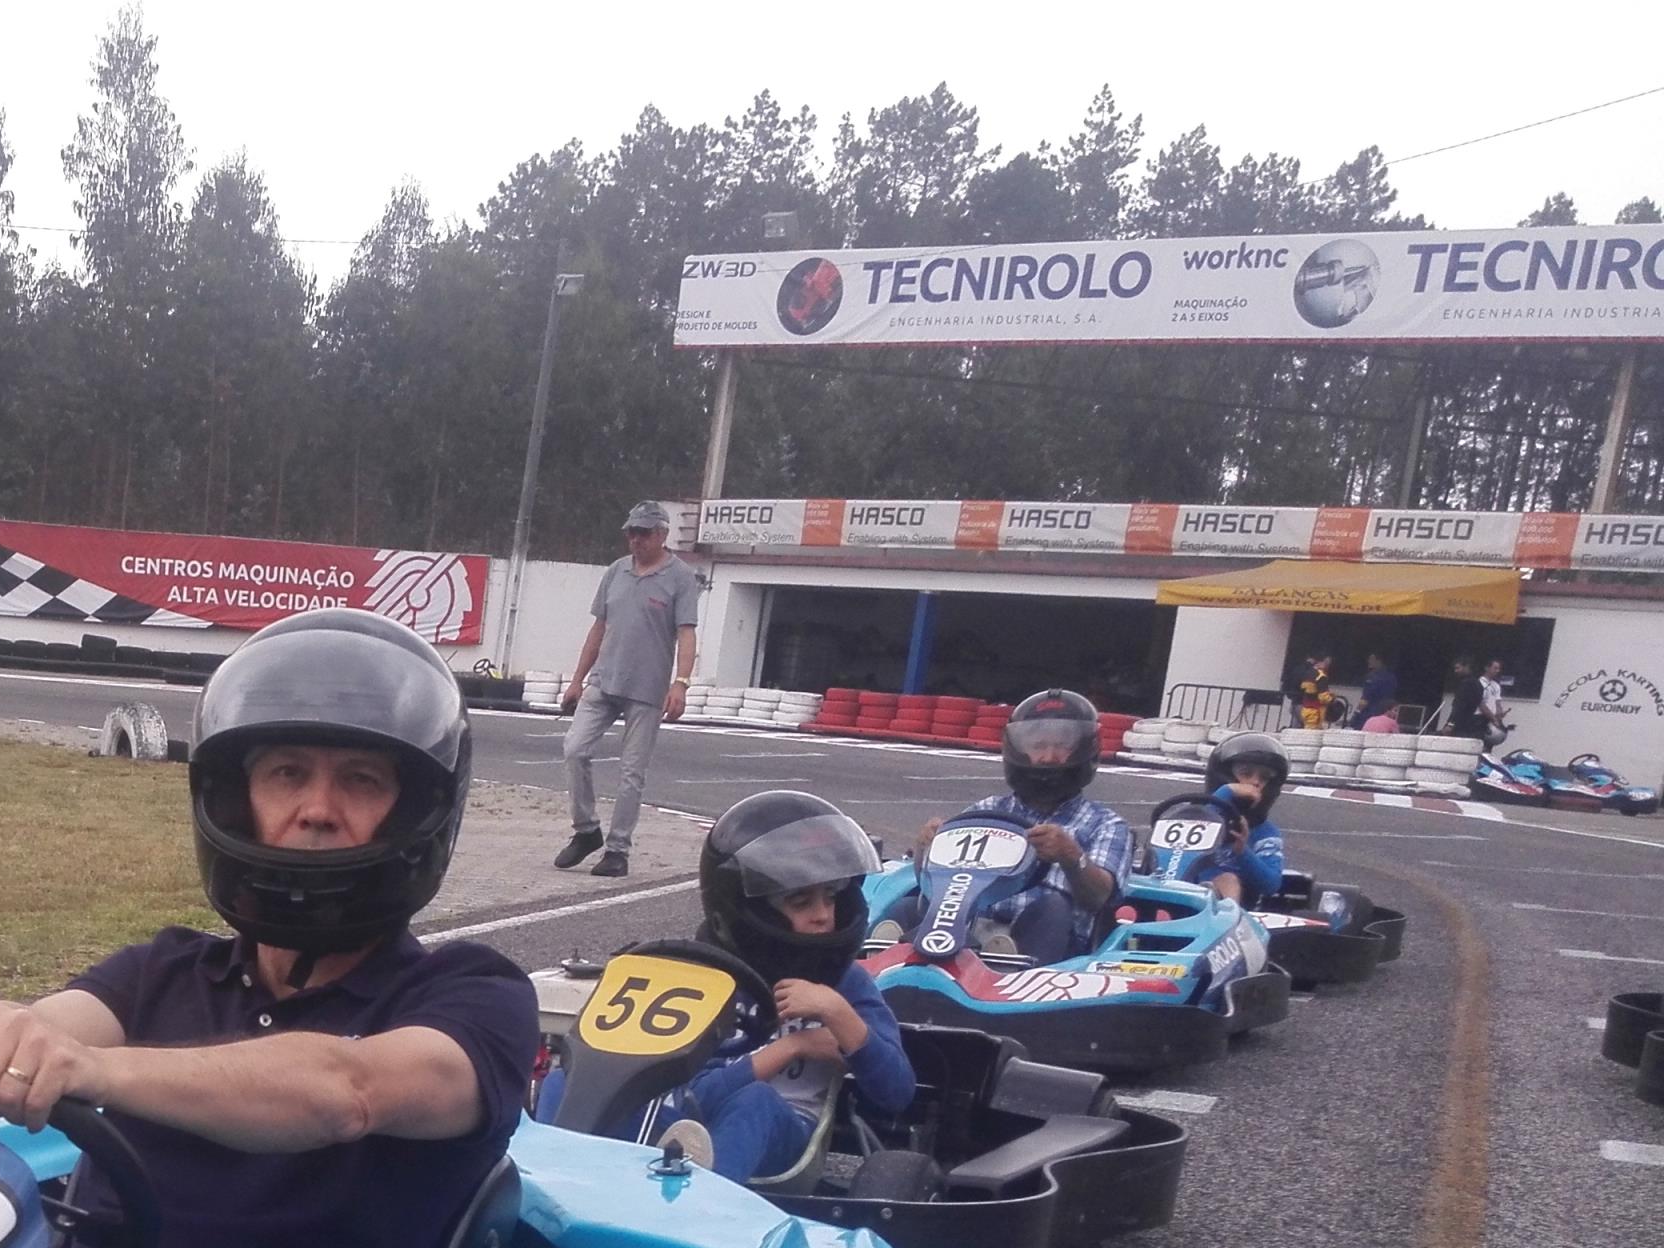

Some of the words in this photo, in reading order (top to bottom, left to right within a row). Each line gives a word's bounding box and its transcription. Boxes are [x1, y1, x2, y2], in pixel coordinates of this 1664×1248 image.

[1183, 241, 1289, 272] worknc
[1406, 237, 1664, 294] TECNIRO
[682, 260, 757, 279] ZW3D
[863, 250, 1153, 305] TECNIROLO
[1173, 296, 1248, 310] MAQUINAÇÃO
[1442, 306, 1554, 321] ENGENHARIA
[1562, 306, 1663, 320] INDUSTRIA
[676, 311, 704, 320] DESIGN
[888, 314, 977, 328] ENGENHARIA
[979, 312, 1068, 327] INDUSTRIAL,
[1073, 311, 1103, 325] S.A.
[1171, 312, 1179, 323] 2
[1180, 312, 1189, 323] A
[1197, 311, 1230, 323] EIXOS
[674, 322, 710, 332] PROJETO
[711, 322, 723, 331] DE
[724, 321, 758, 331] MOLDES
[704, 506, 774, 525] HASCO
[848, 506, 926, 526] HASCO
[1007, 508, 1093, 529] HASCO
[1182, 511, 1275, 534] HASCO
[1372, 517, 1476, 541] HASCO
[1584, 522, 1664, 546] HASC
[1004, 536, 1049, 549] Enabling
[1179, 540, 1228, 554] Enabling
[121, 555, 214, 580] CENTROS
[218, 561, 355, 590] MAQUINAÇÃO
[167, 586, 220, 606] ALTA
[224, 588, 348, 611] VELOCIDADE
[1554, 669, 1608, 709] ESCOLA
[1617, 668, 1664, 716] KARTING
[1580, 701, 1642, 714] EUROINDY
[1164, 822, 1207, 846] 66
[955, 834, 991, 862] 11
[594, 976, 706, 1037] 56
